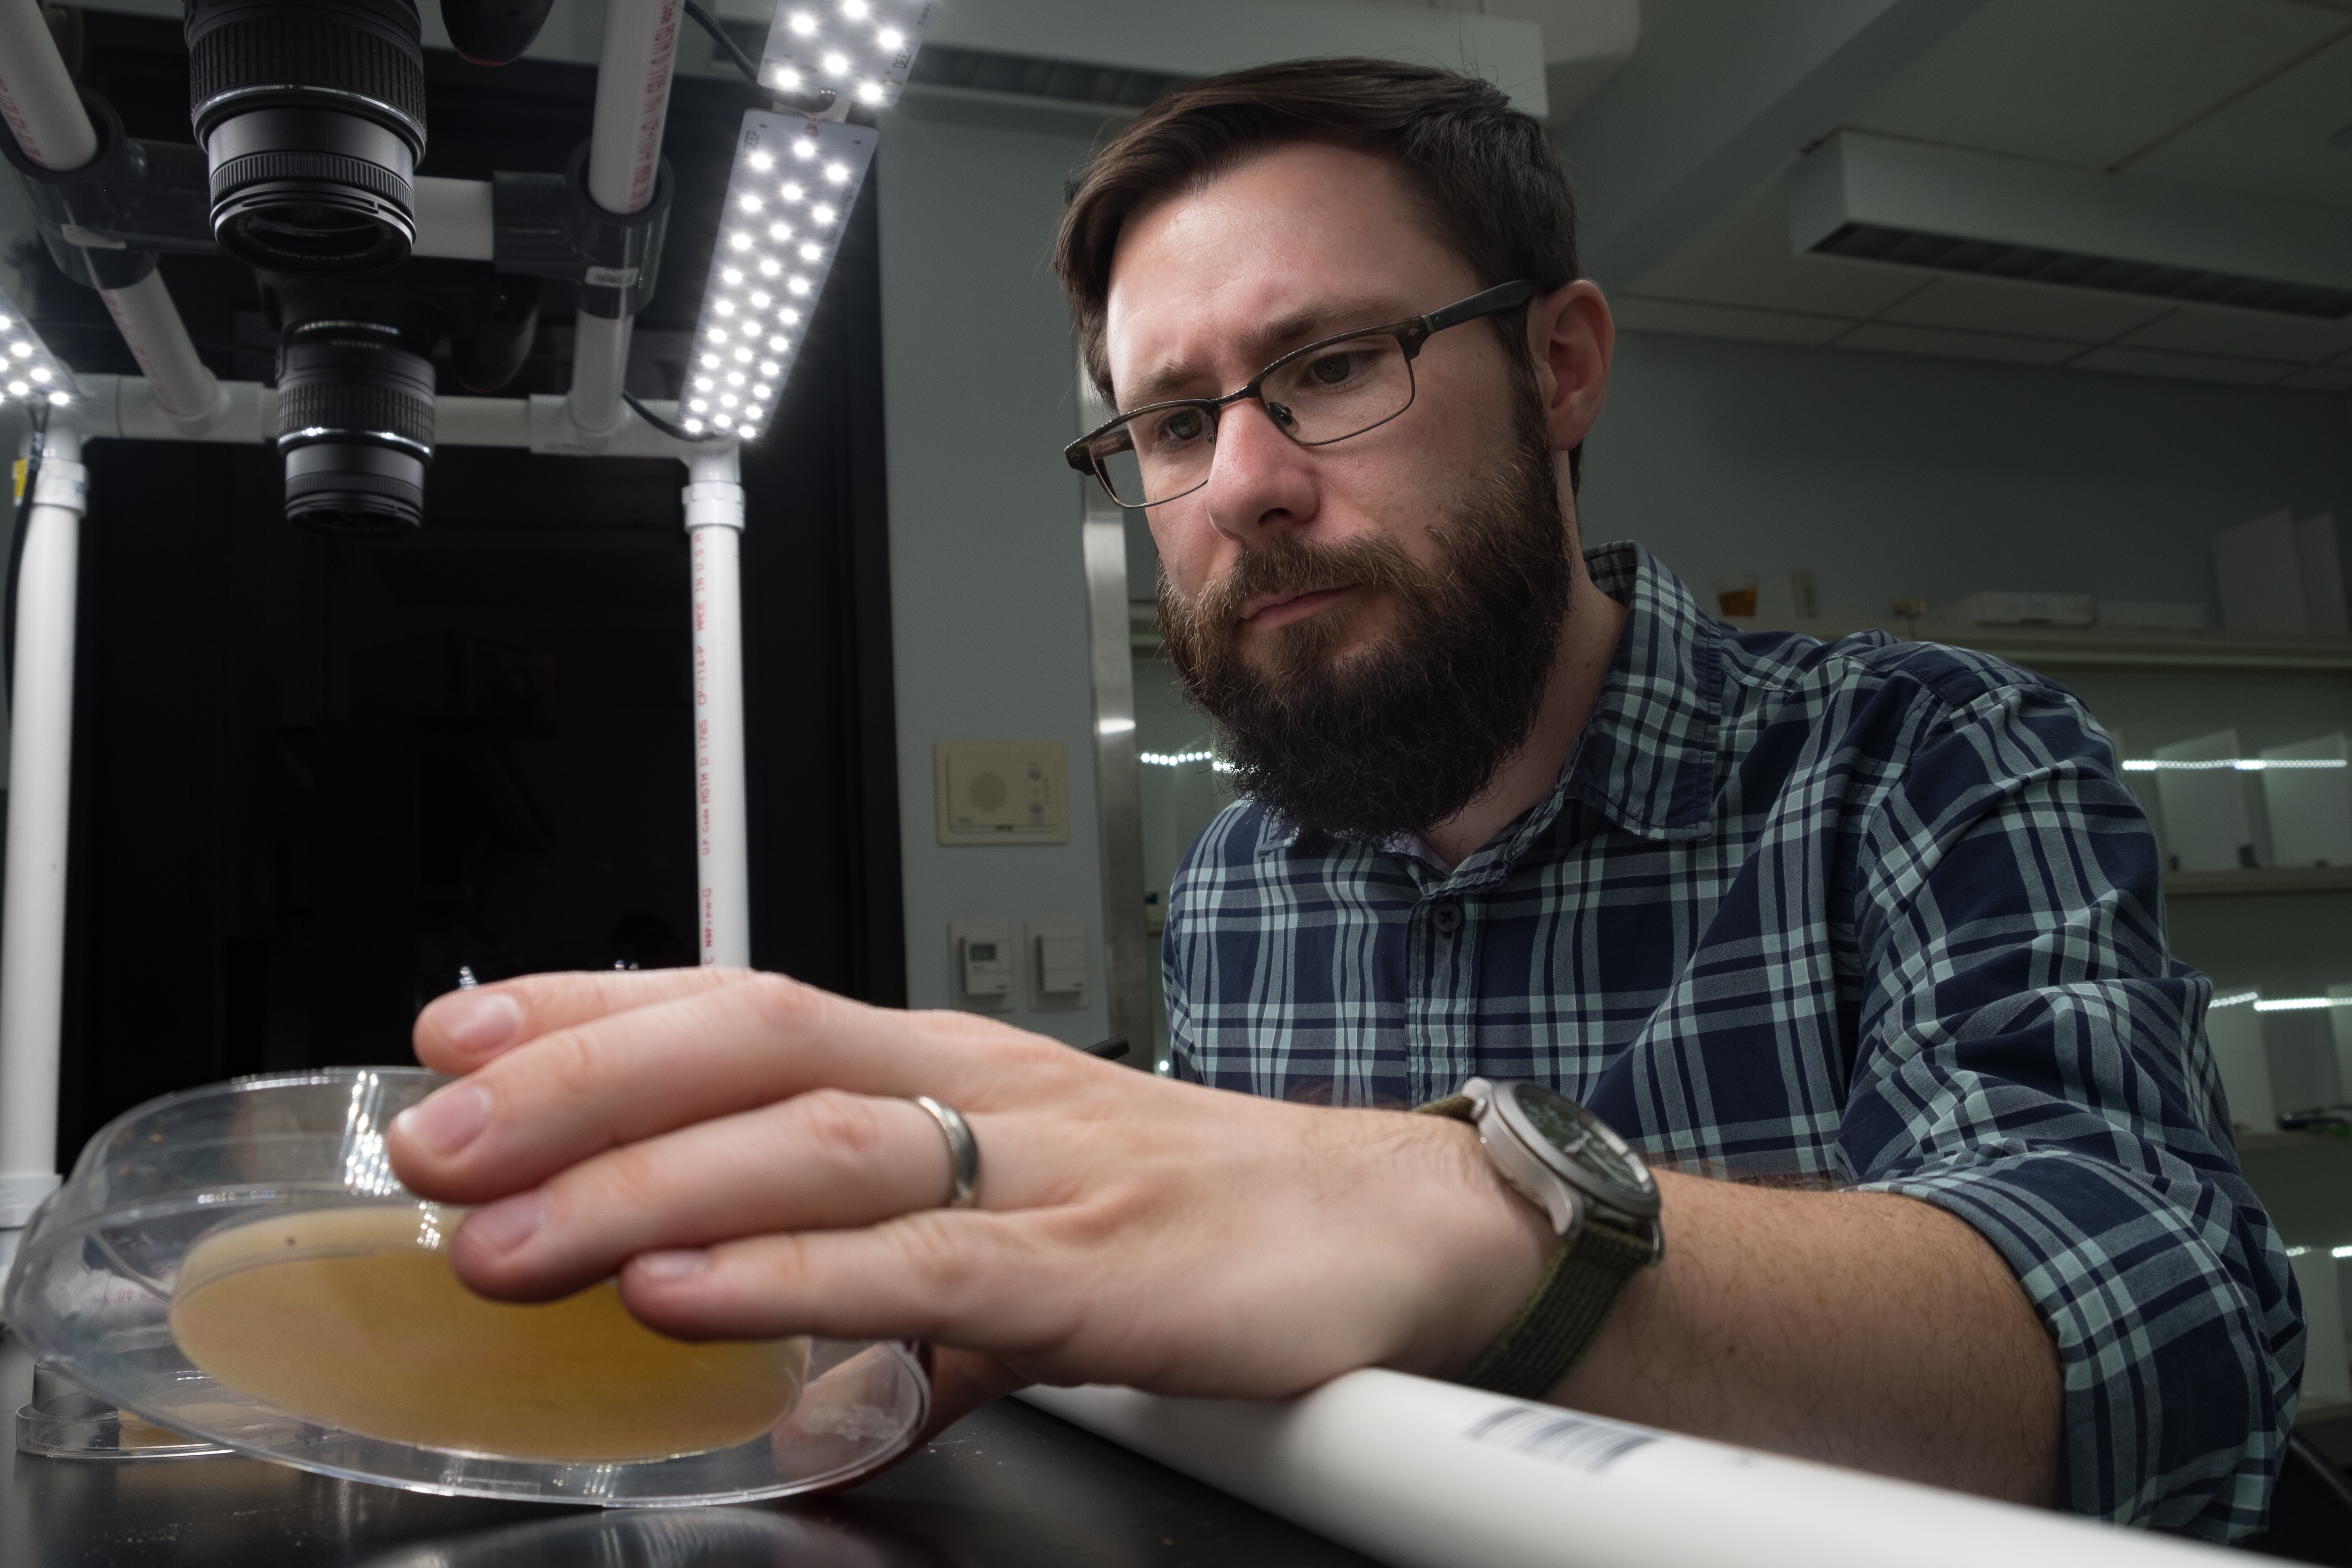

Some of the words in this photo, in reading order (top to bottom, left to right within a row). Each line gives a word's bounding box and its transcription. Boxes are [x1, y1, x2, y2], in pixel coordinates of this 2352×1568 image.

[694, 578, 704, 593] IN
[695, 600, 705, 631] MADE
[698, 719, 707, 749] 1785
[699, 758, 708, 766] D
[699, 773, 709, 804] ASTM
